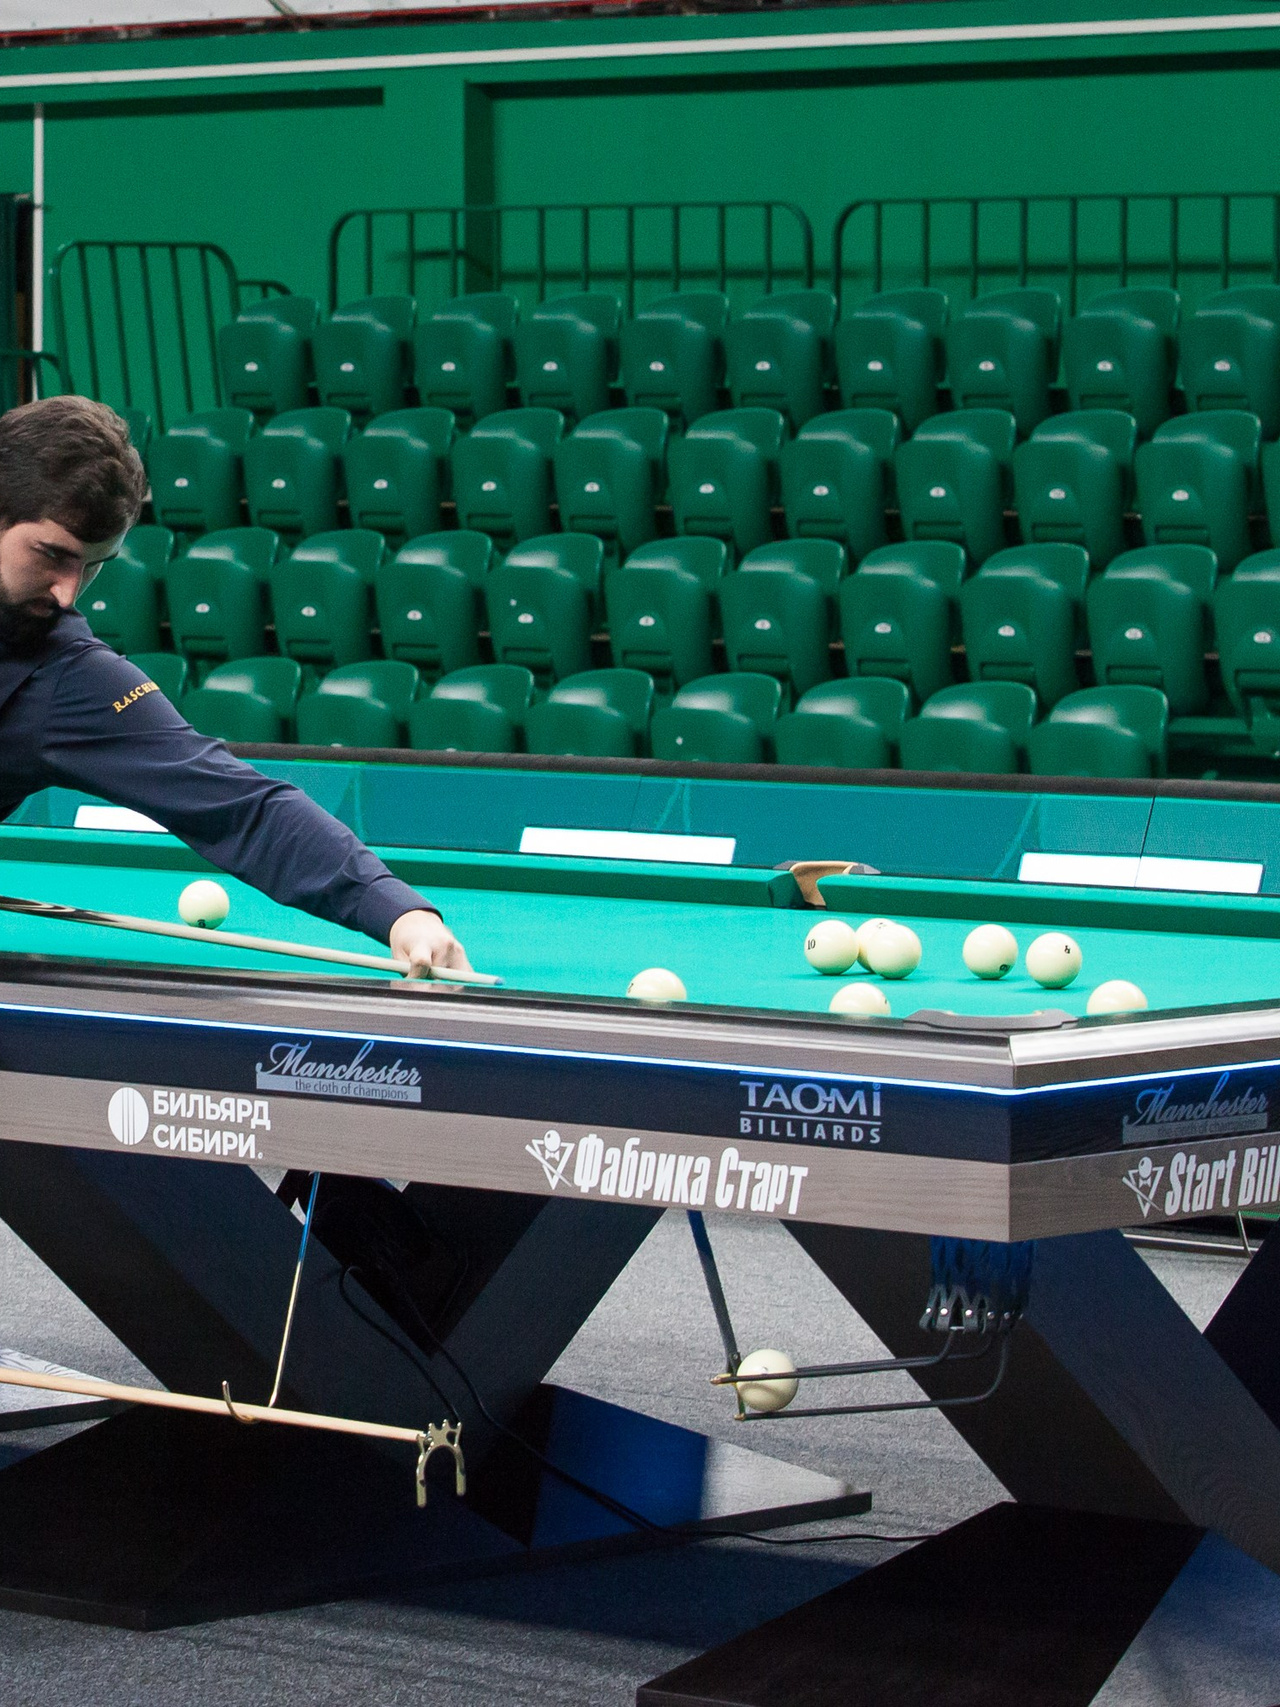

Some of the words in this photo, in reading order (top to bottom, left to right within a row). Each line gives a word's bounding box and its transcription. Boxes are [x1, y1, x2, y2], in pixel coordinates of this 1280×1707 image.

[255, 1039, 422, 1086] Manchester
[153, 1090, 271, 1130] БИЛЬЯРД
[295, 1079, 311, 1091] the
[314, 1081, 335, 1094] cloth
[339, 1083, 351, 1095] of
[353, 1084, 409, 1100] champions
[1122, 1071, 1269, 1127] Manchester
[739, 1117, 881, 1144] BILLIARDS
[573, 1133, 711, 1206] Фабрика
[714, 1147, 809, 1215] Старт
[1164, 1150, 1237, 1216] Start
